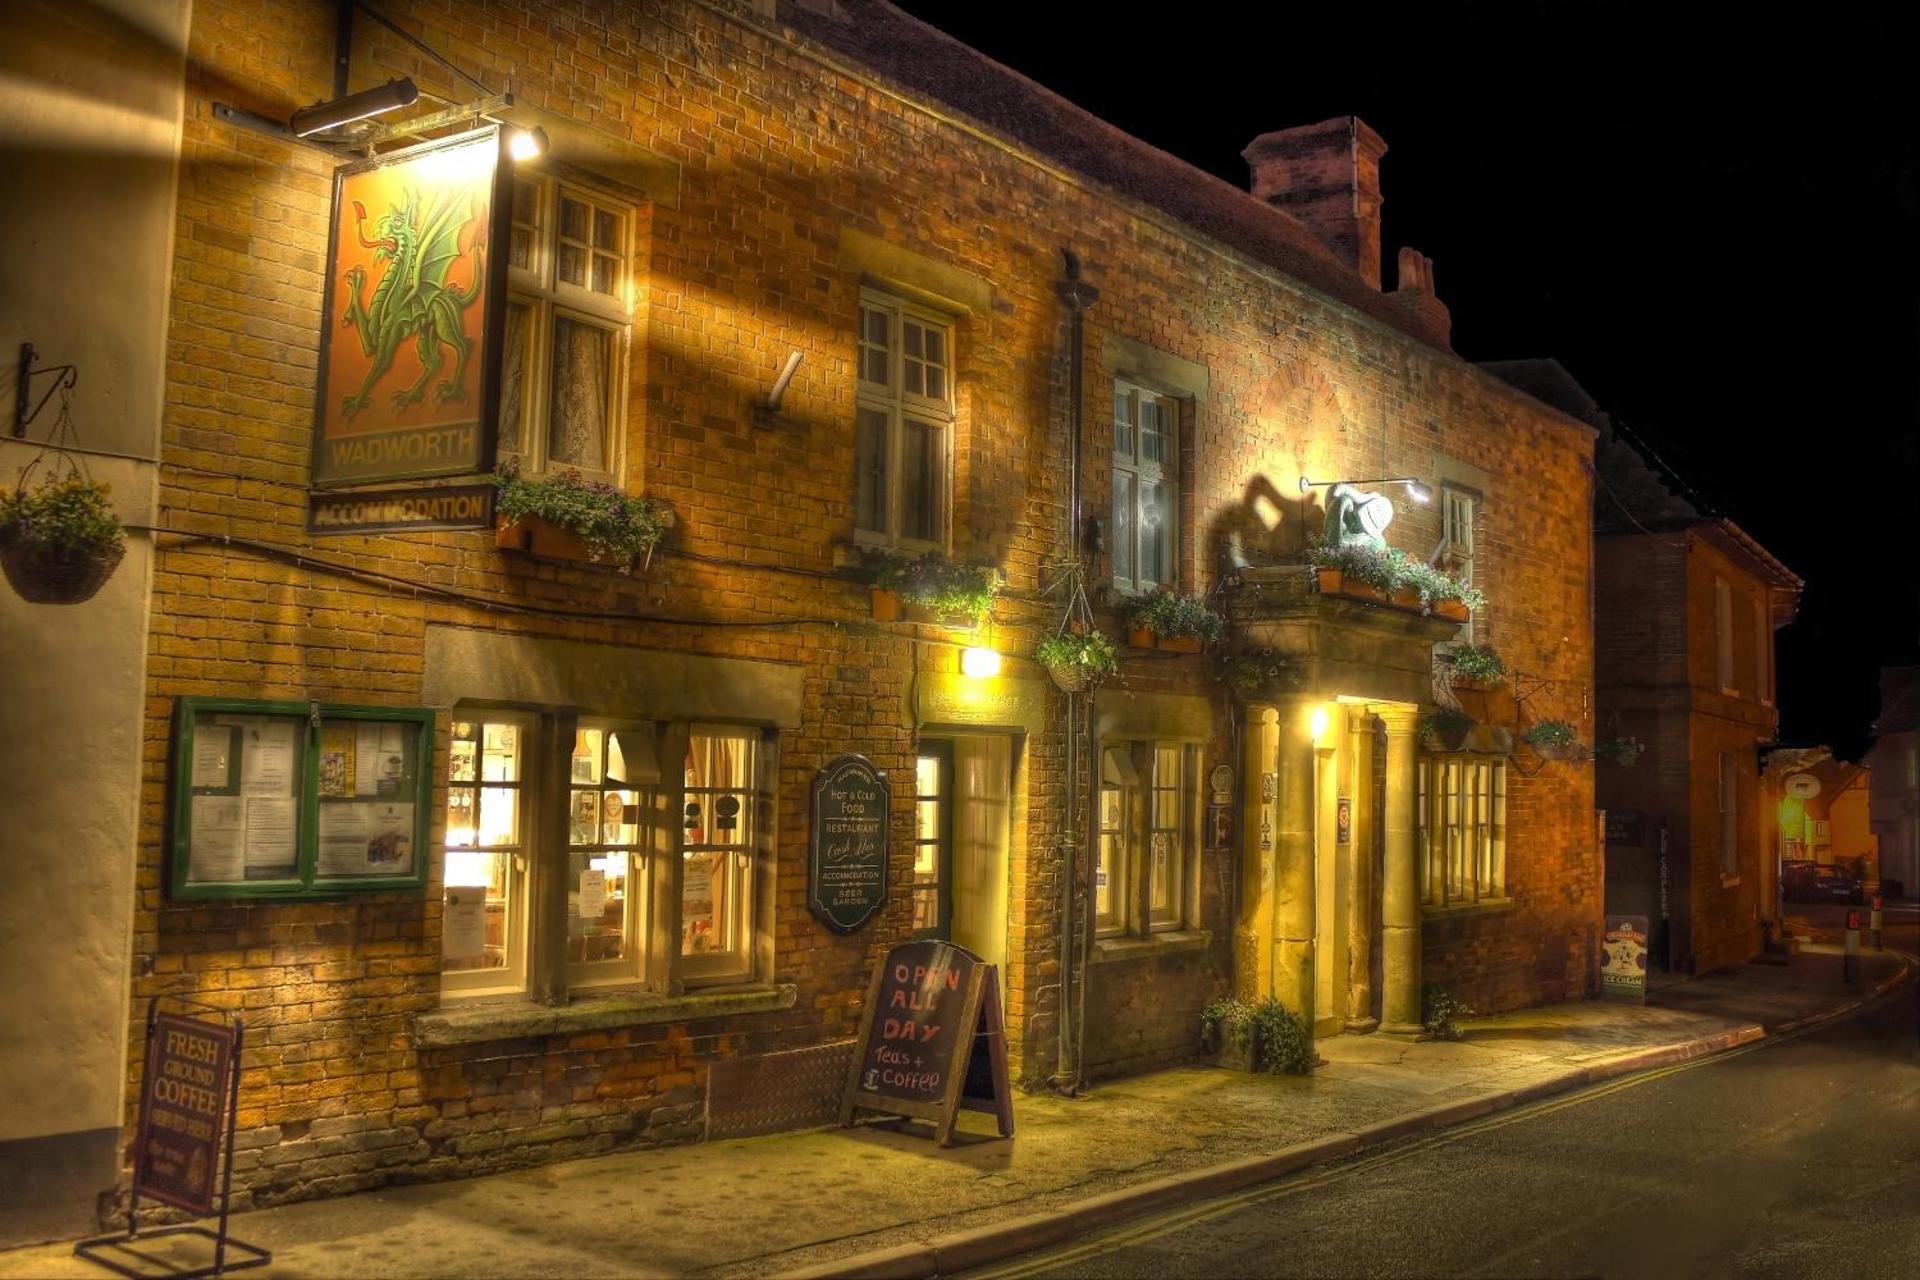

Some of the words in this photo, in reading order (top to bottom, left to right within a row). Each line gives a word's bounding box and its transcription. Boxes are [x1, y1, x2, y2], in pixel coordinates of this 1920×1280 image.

[331, 427, 475, 468] WADWORTH
[314, 496, 483, 526] ACCOMMODATION
[826, 823, 879, 833] RESTAURANT
[895, 964, 961, 991] OPEN
[1615, 976, 1642, 986] CREAM
[890, 989, 938, 1011] ALL
[882, 1017, 942, 1043] DAY
[166, 1031, 219, 1065] FRESH
[874, 1045, 910, 1066] Teas
[164, 1060, 215, 1086] GROUND
[882, 1068, 940, 1093] Coffee
[155, 1077, 219, 1116] COFFEE
